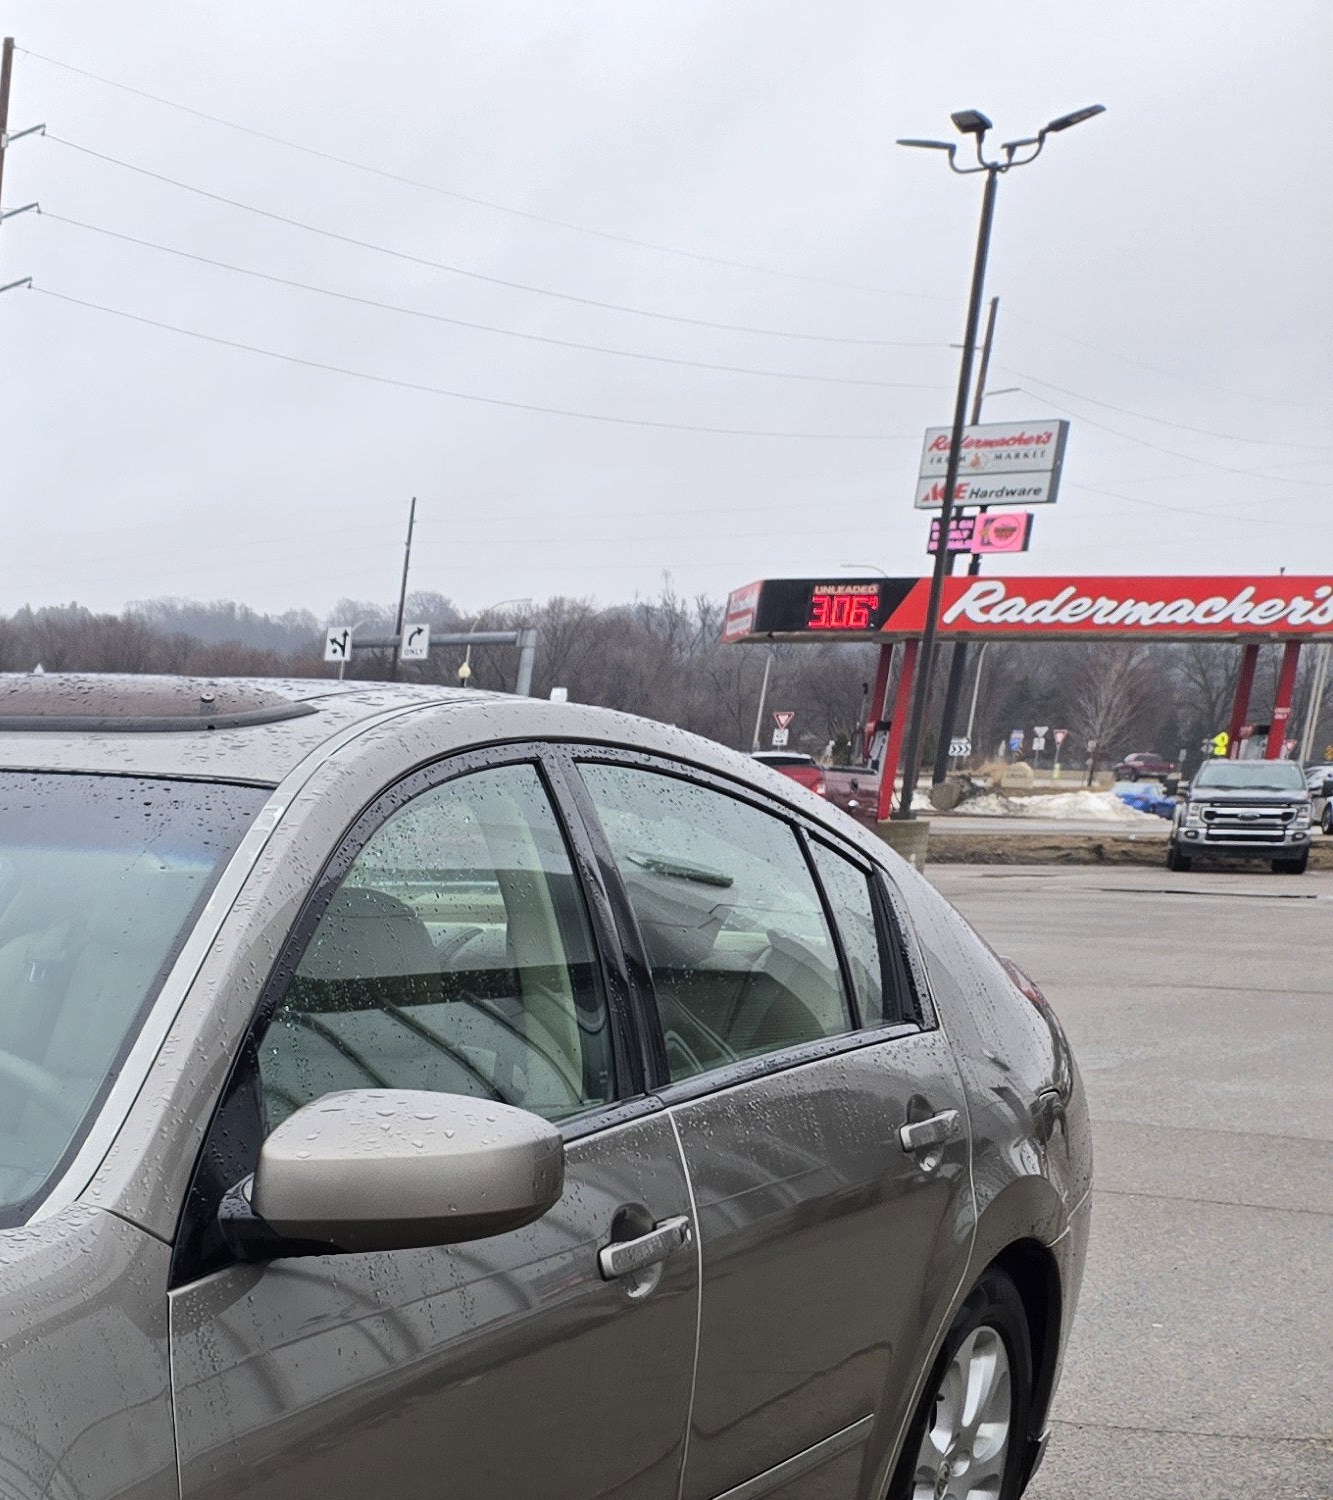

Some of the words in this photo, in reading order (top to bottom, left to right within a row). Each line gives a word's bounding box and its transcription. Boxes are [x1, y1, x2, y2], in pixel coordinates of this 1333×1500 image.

[994, 450, 1046, 461] MARKET
[969, 485, 1042, 499] Hardware
[814, 584, 880, 595] UNLEADED
[943, 580, 1333, 626] Radermacher's
[404, 648, 423, 656] ONLY
